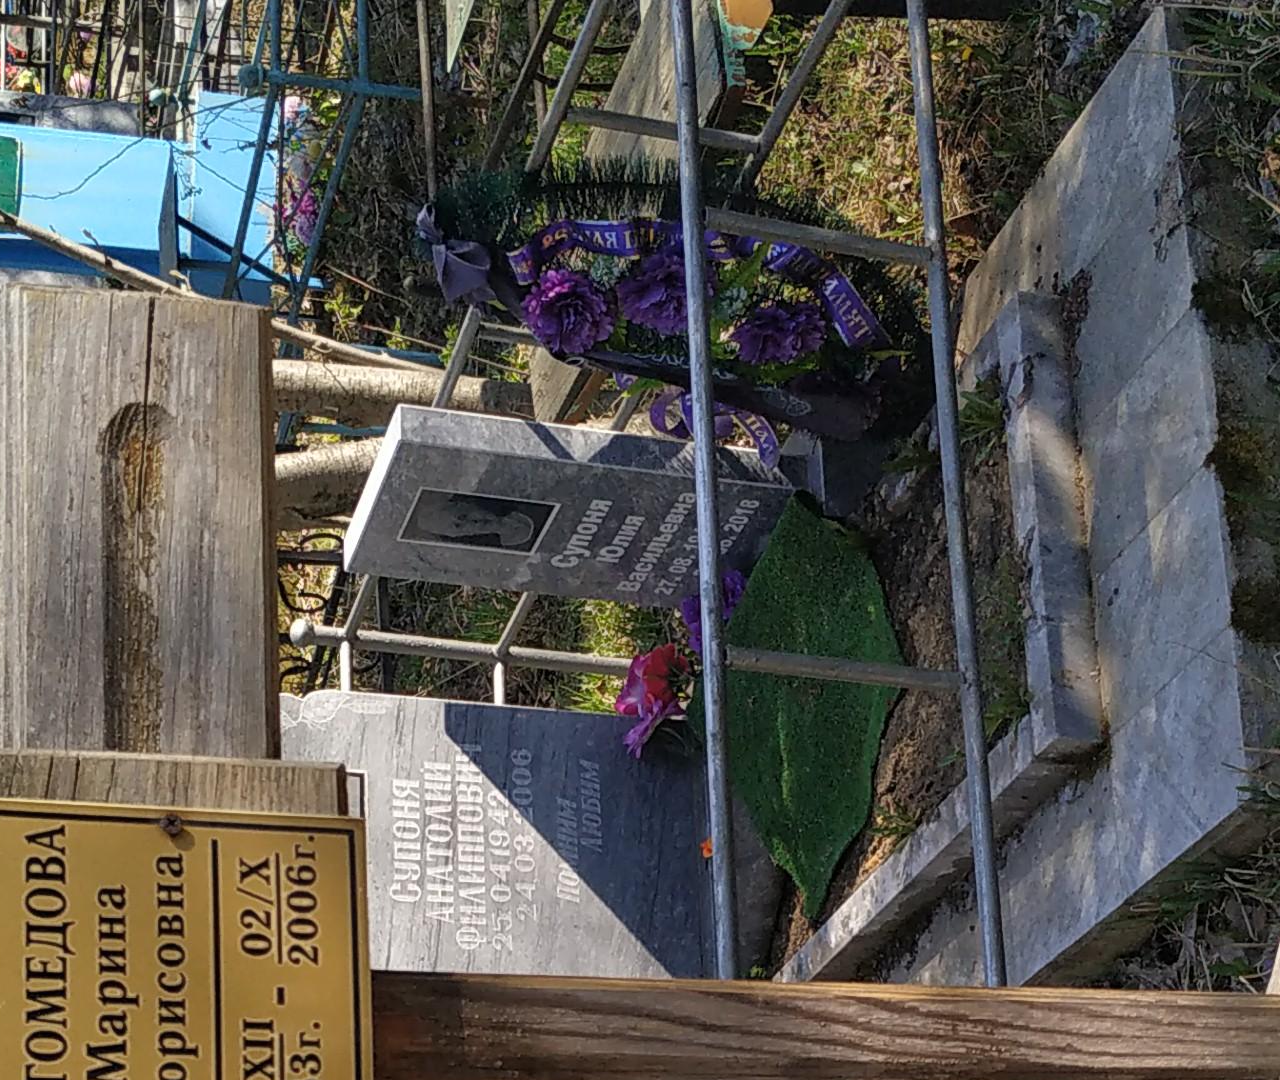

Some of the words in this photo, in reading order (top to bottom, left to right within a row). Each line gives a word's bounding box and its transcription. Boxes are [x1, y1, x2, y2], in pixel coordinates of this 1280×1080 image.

[550, 499, 614, 568] Супоня
[595, 514, 646, 564] Юлия
[615, 492, 696, 592] Васильевна
[389, 778, 421, 902] СУПОНЯ
[420, 762, 455, 923] АНАТОЛИЙ
[455, 743, 486, 951] ФИЛИППОВИЧ
[556, 797, 580, 903] ПОМНИМ
[579, 758, 603, 853] ЛЮБИМ
[238, 856, 274, 957] 02/X
[286, 834, 320, 967] 2006г.
